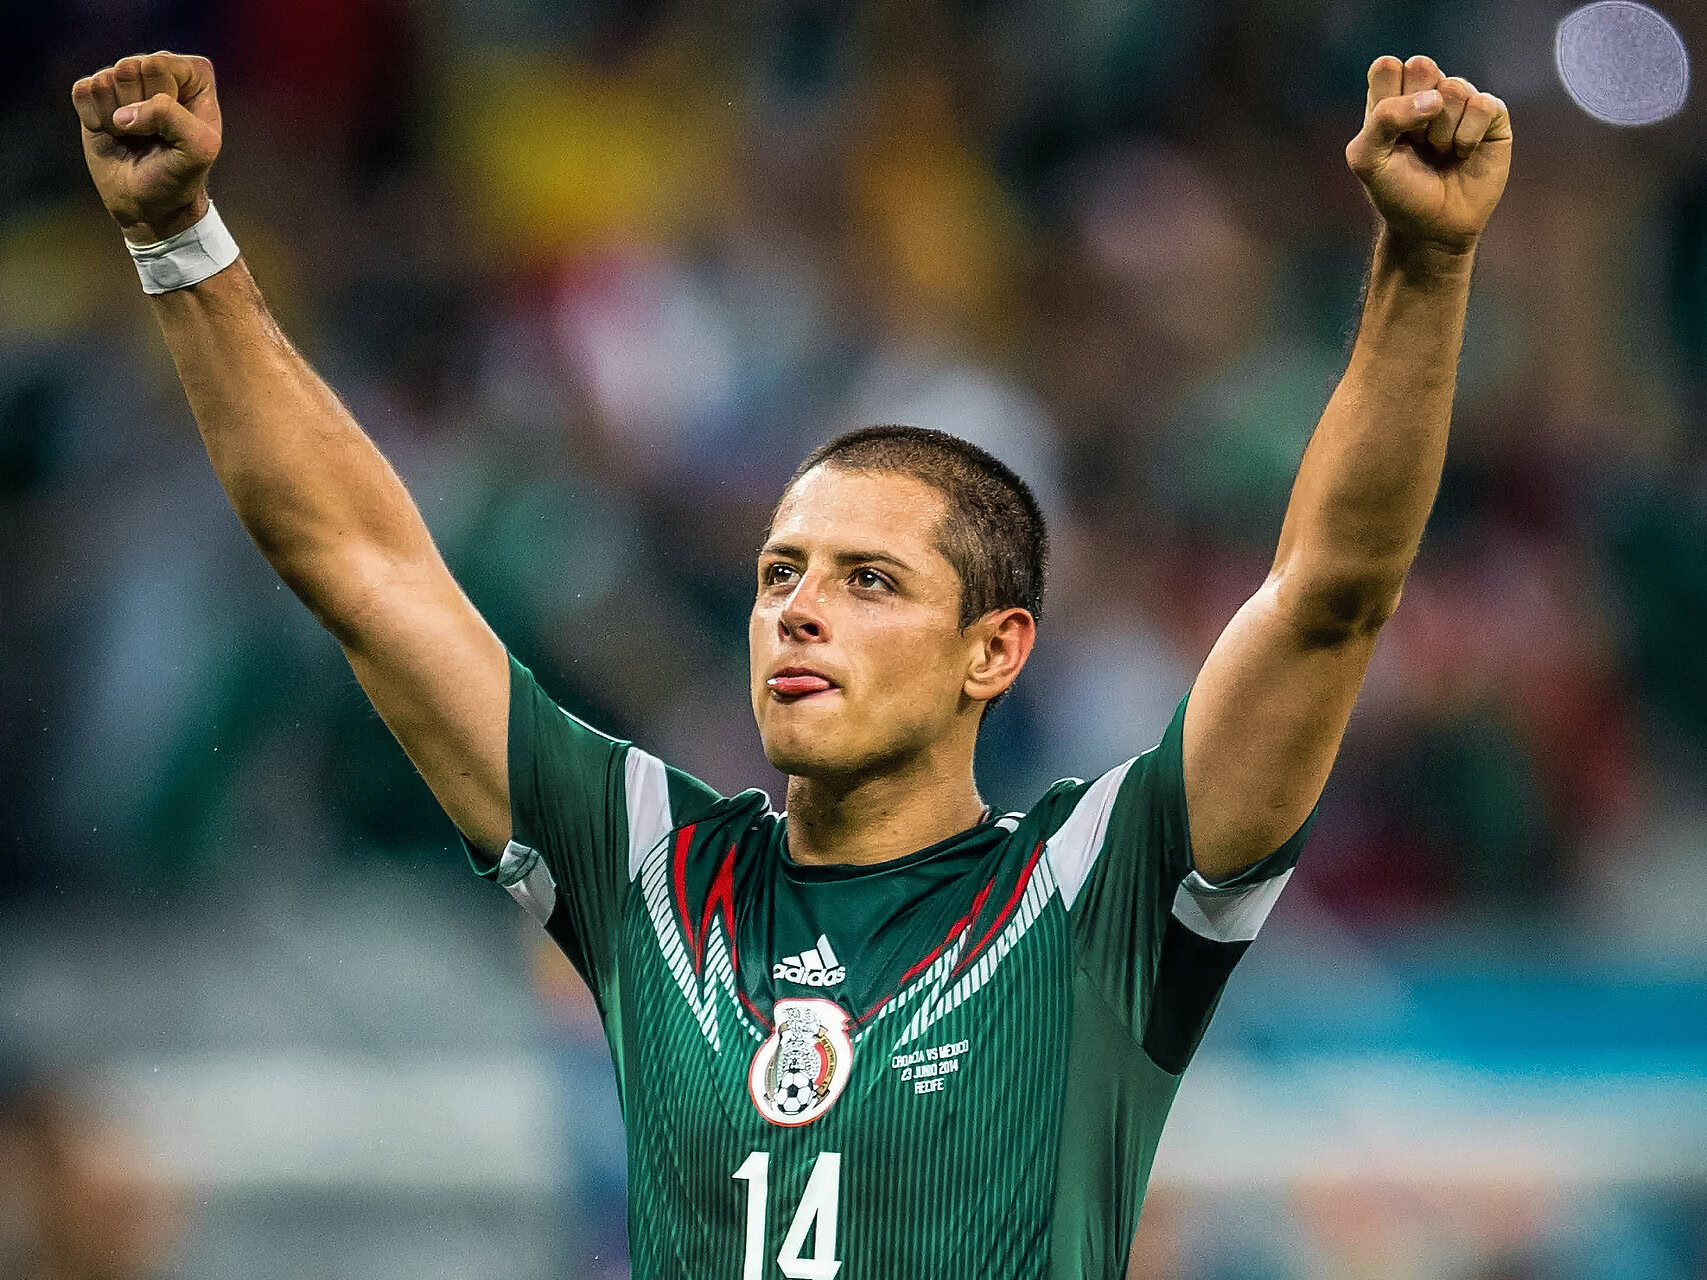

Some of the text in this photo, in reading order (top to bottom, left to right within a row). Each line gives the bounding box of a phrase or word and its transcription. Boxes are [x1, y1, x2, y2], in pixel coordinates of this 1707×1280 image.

[773, 964, 846, 987] adidas
[892, 1050, 925, 1068] CROACIA
[926, 1048, 938, 1060] VS
[901, 1059, 958, 1081] 23 JUNIO 2014
[914, 1078, 944, 1094] RECIFE
